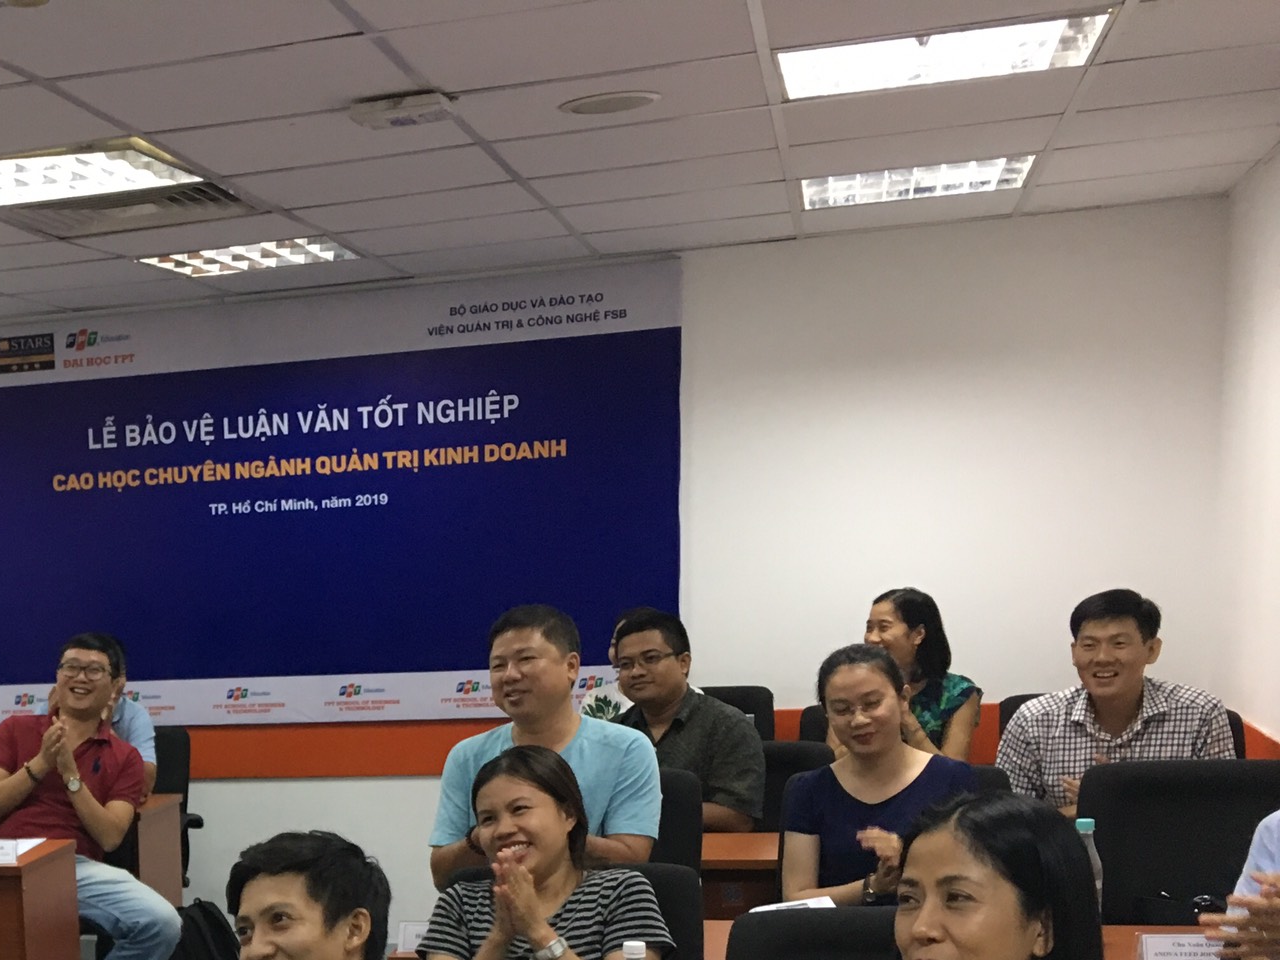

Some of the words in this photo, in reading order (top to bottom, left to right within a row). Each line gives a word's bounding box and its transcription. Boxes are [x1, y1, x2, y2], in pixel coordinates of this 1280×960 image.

[470, 302, 499, 315] GIÁO
[502, 300, 527, 313] DỤC
[530, 296, 546, 309] VÀ
[549, 294, 575, 307] ĐÀO
[578, 292, 604, 305] TẠO
[427, 322, 454, 336] VIỆN
[494, 319, 513, 332] TRỊ
[516, 317, 524, 329] &
[527, 314, 563, 327] CÔNG
[566, 309, 600, 323] NGHỆ
[604, 308, 627, 320] FSB
[11, 336, 52, 351] STARS
[65, 328, 99, 351] FPT
[87, 415, 118, 450] LỄ
[125, 414, 177, 447] BẢO
[182, 412, 215, 446] VỆ
[223, 407, 289, 442] LUẬN
[296, 403, 349, 434] VĂN
[357, 394, 409, 429] TỐT
[417, 389, 520, 425] NGHIỆP
[52, 472, 94, 492] CAO
[97, 468, 141, 493] HỌC
[144, 459, 231, 486] CHUYÊN
[235, 455, 312, 480] NGÀNH
[315, 447, 379, 475] QUẢN
[382, 449, 419, 473] TRỊ
[423, 445, 479, 467] KINH
[483, 438, 568, 463] DOANH
[209, 503, 229, 516] TP.
[232, 500, 251, 514] Hồ
[254, 498, 278, 513] Chí
[280, 497, 318, 512] Minh,
[321, 495, 351, 509] năm
[355, 492, 388, 507] 2019
